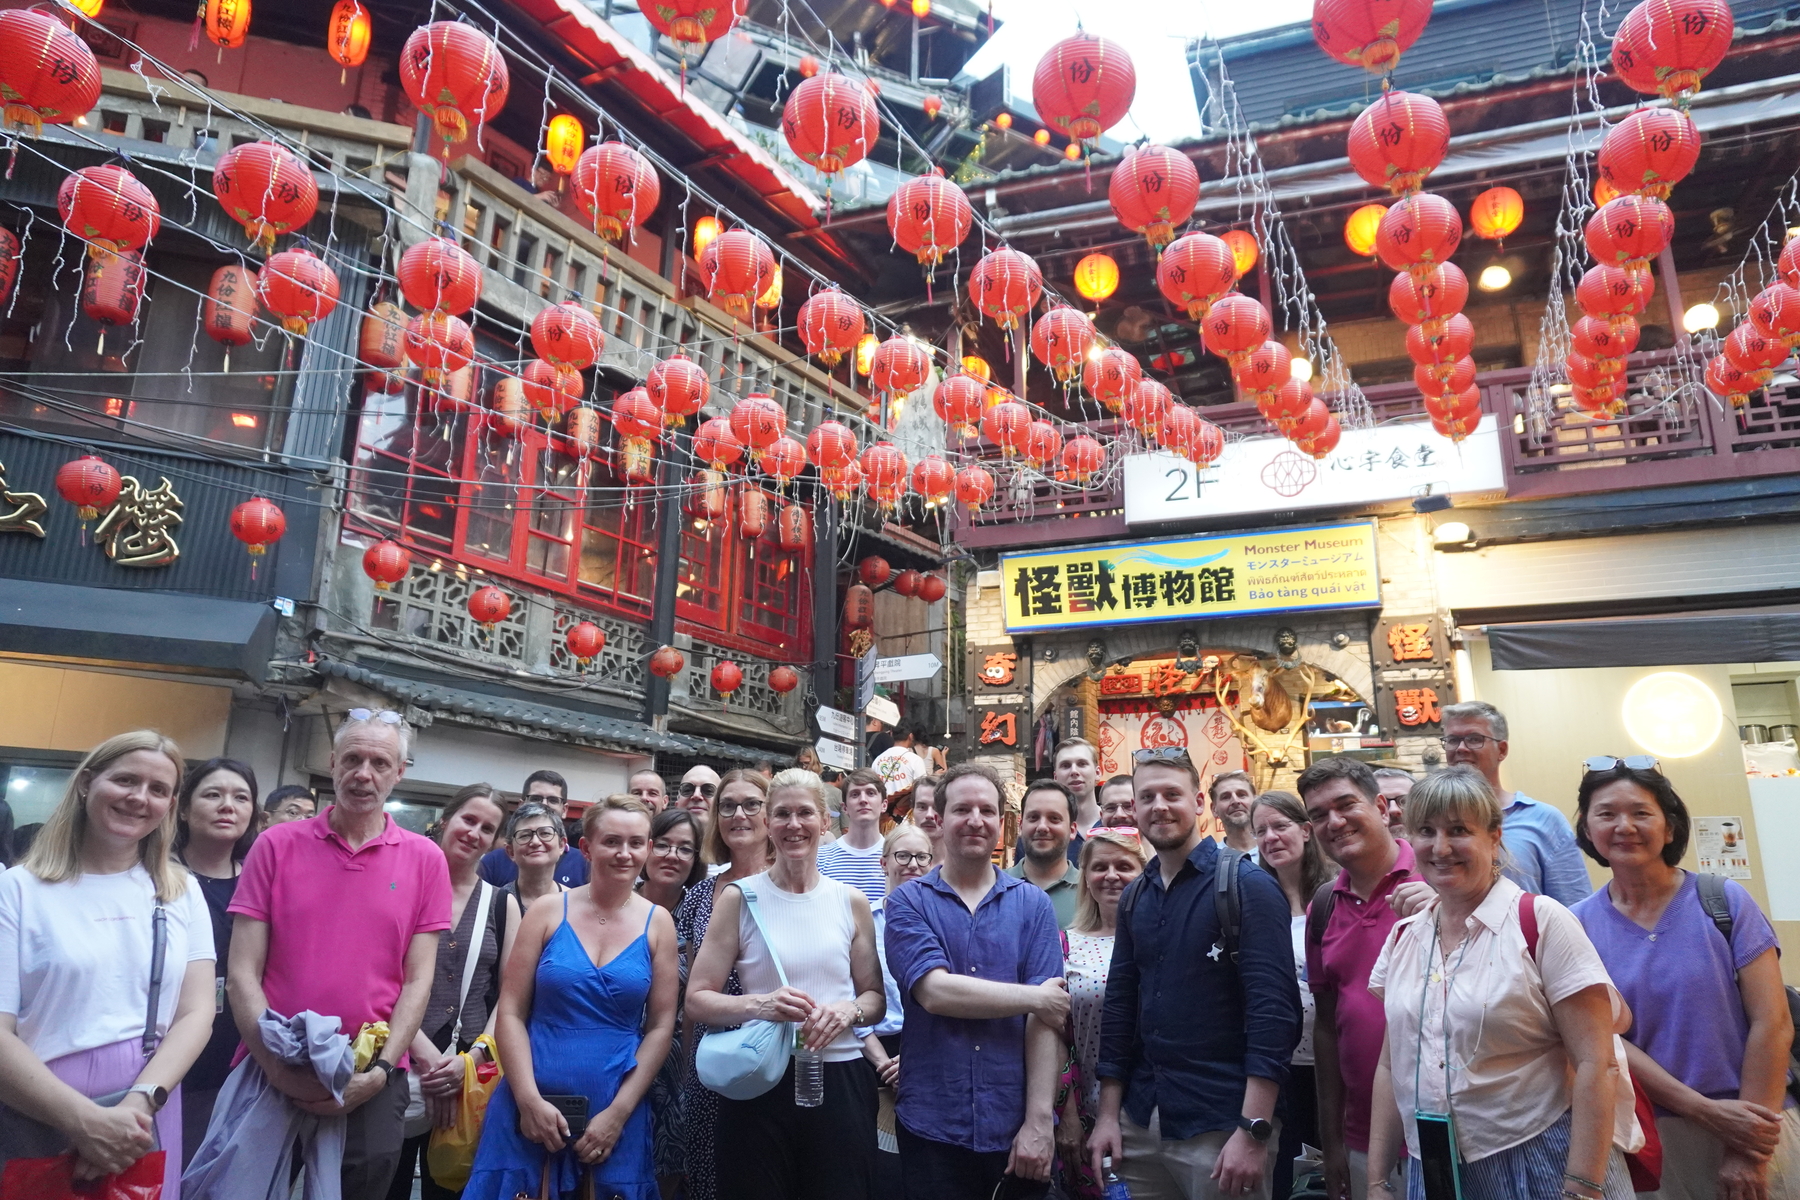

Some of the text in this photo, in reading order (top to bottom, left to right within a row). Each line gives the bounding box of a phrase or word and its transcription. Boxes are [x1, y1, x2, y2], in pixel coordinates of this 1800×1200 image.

[1682, 10, 1711, 35] 份
[837, 77, 863, 129] 九份
[1648, 108, 1675, 152] 九份
[277, 156, 309, 205] 九份
[1142, 147, 1166, 193] 九份
[1615, 199, 1637, 239] 九份
[1170, 243, 1187, 285] 九份
[215, 270, 239, 328] 九份紅樓
[1612, 279, 1631, 297] 份
[547, 305, 566, 343] 九份
[839, 294, 855, 332] 九份
[1214, 298, 1231, 336] 九份
[381, 308, 400, 357] 九份紅樓
[1594, 332, 1611, 347] 份
[1750, 337, 1767, 352] 份
[1728, 369, 1742, 382] 份
[760, 401, 776, 435] 九份
[89, 464, 107, 495] 九份
[1165, 464, 1221, 502] 2F
[1244, 537, 1363, 556] Monster Museum
[1246, 552, 1364, 571] モンスターミュージアム
[1014, 557, 1236, 617] 怪獸博物館
[1249, 581, 1366, 600] Bảo tàng quái vật
[1069, 709, 1080, 738] 館內陰
